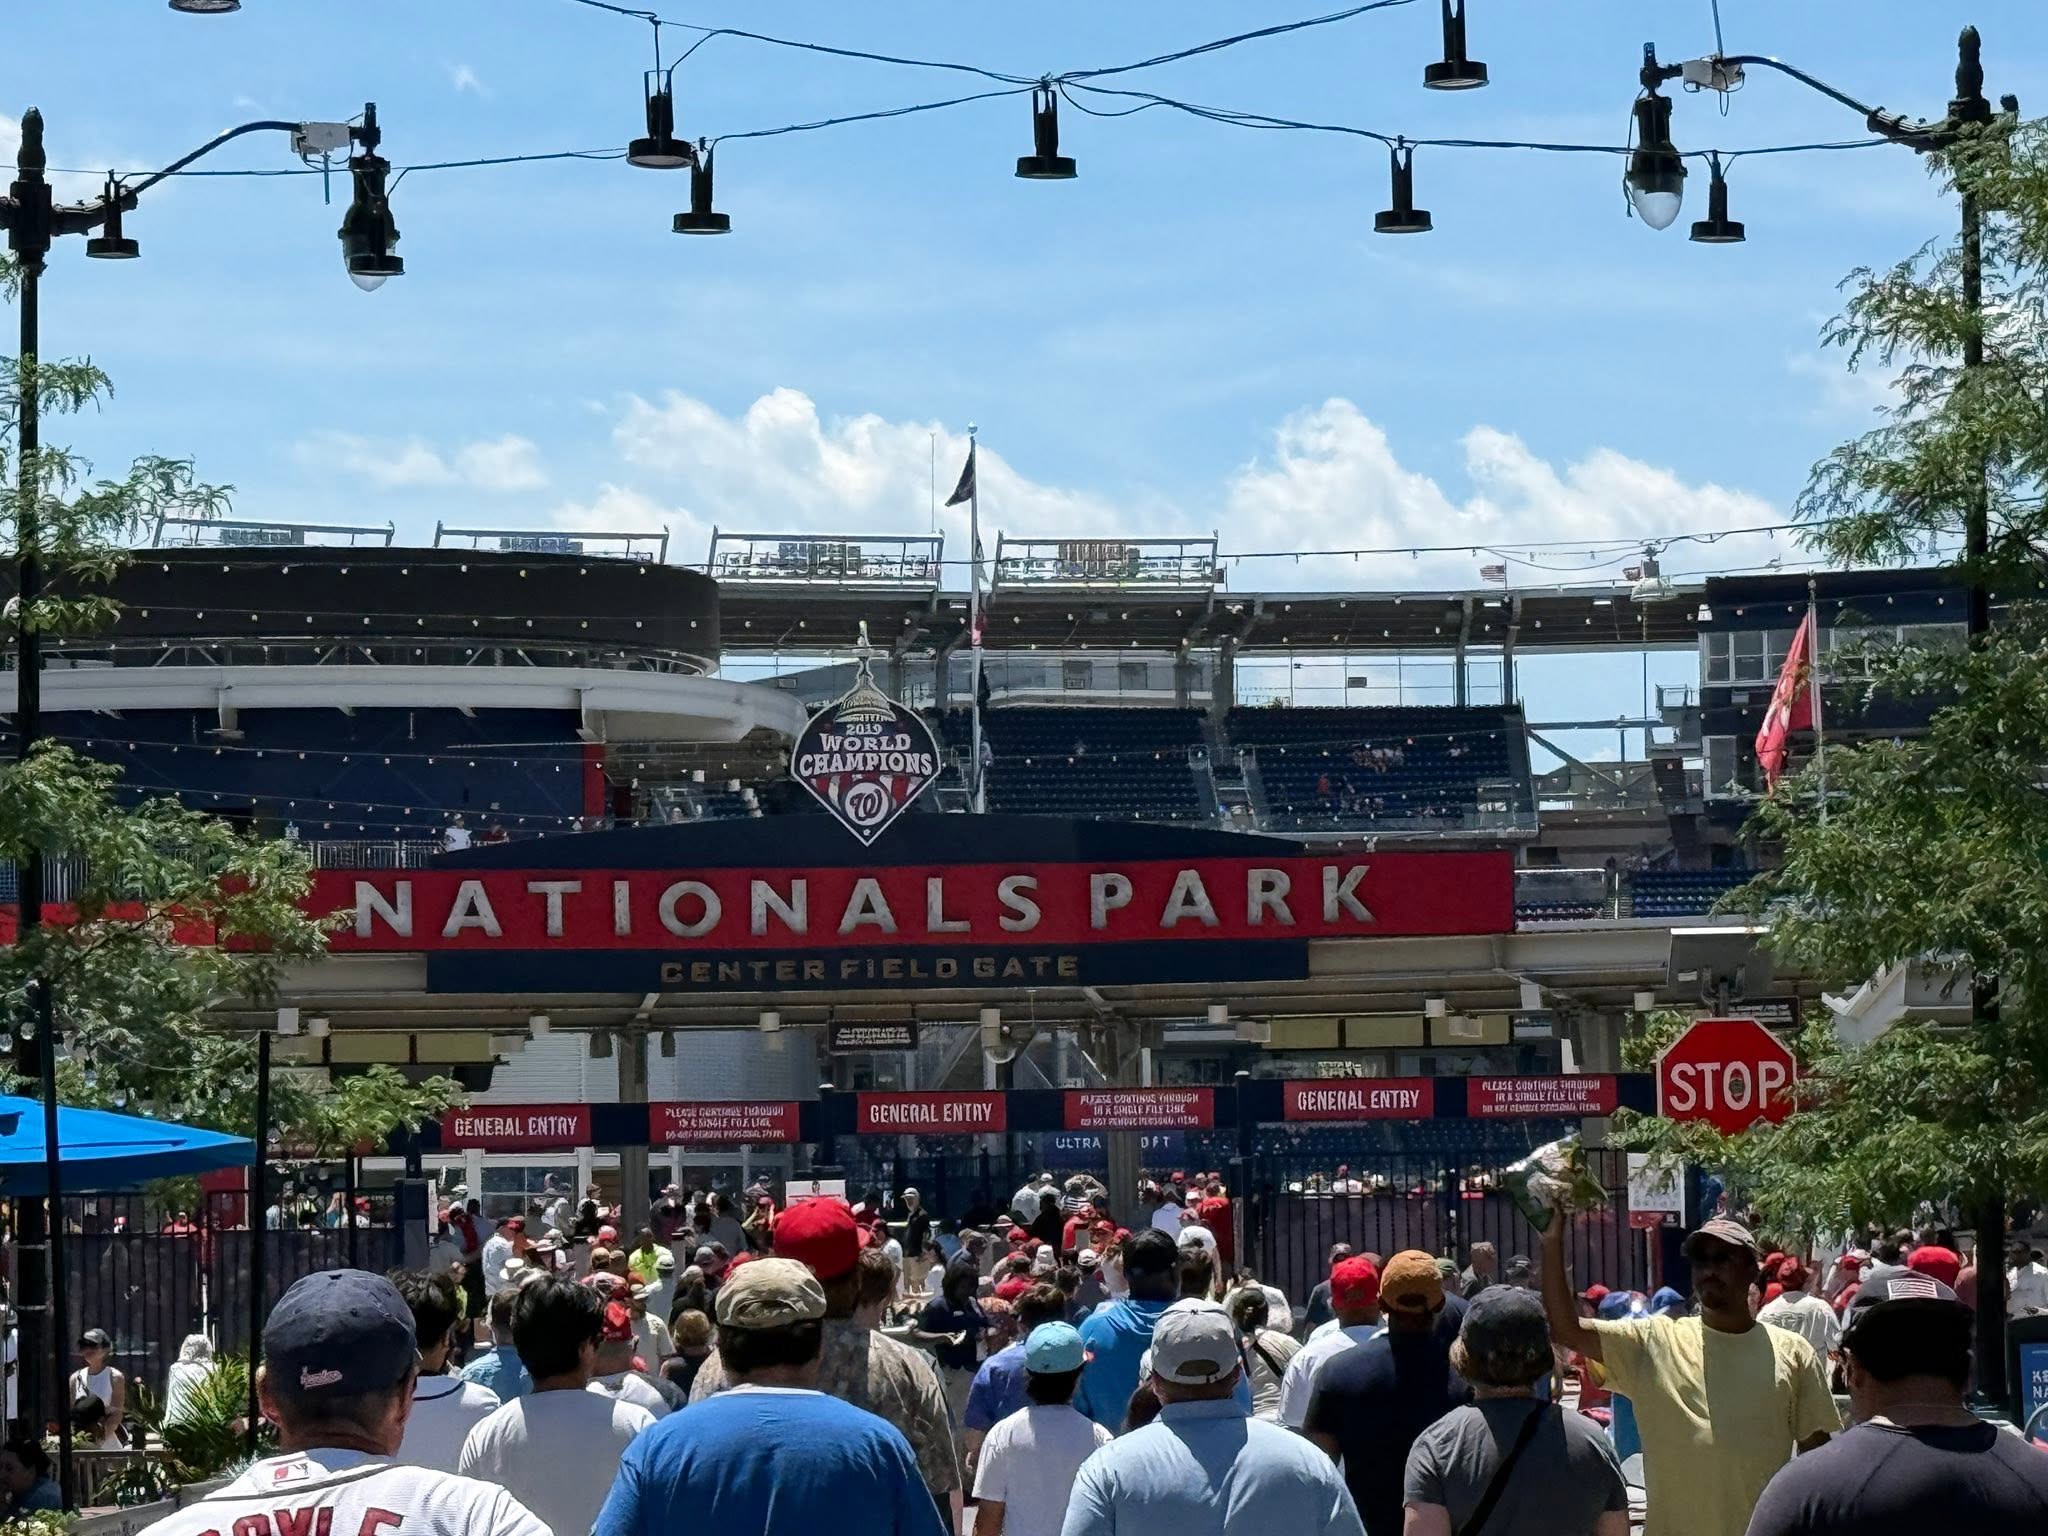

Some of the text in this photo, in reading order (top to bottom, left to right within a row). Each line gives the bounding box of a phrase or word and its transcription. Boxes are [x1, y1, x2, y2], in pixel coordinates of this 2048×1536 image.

[846, 723, 883, 736] 2019
[819, 733, 912, 751] WORLD
[800, 753, 933, 777] CHAMPIONS
[355, 866, 1375, 938] NATIONALS PARK
[660, 955, 1079, 983] CENTER FIELD GATE
[1669, 1061, 1786, 1111] STOP
[1297, 1089, 1420, 1111] GENERAL ENTRY
[870, 1102, 993, 1123] GENERAL ENTRY
[454, 1115, 578, 1137] GENERAL ENTRY
[1055, 1136, 1101, 1149] ULTRA
